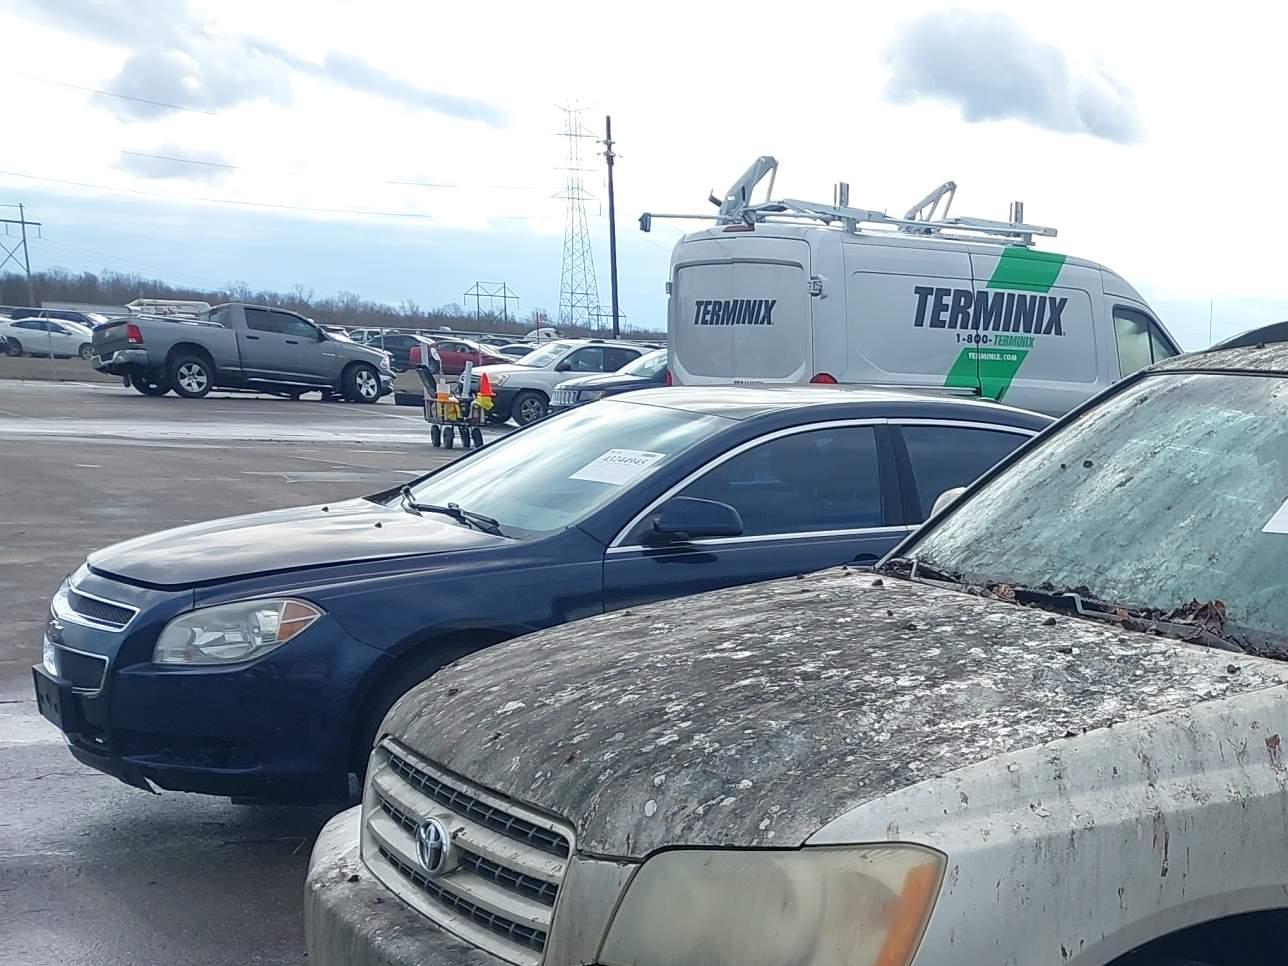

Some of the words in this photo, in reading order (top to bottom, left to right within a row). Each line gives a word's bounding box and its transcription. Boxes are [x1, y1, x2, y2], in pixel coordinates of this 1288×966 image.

[694, 299, 777, 326] TERMINIX
[913, 286, 1068, 336] TERMINIX
[956, 333, 1036, 348] 1-800-TERMINIX
[968, 352, 1018, 362] TERMINIX.COM
